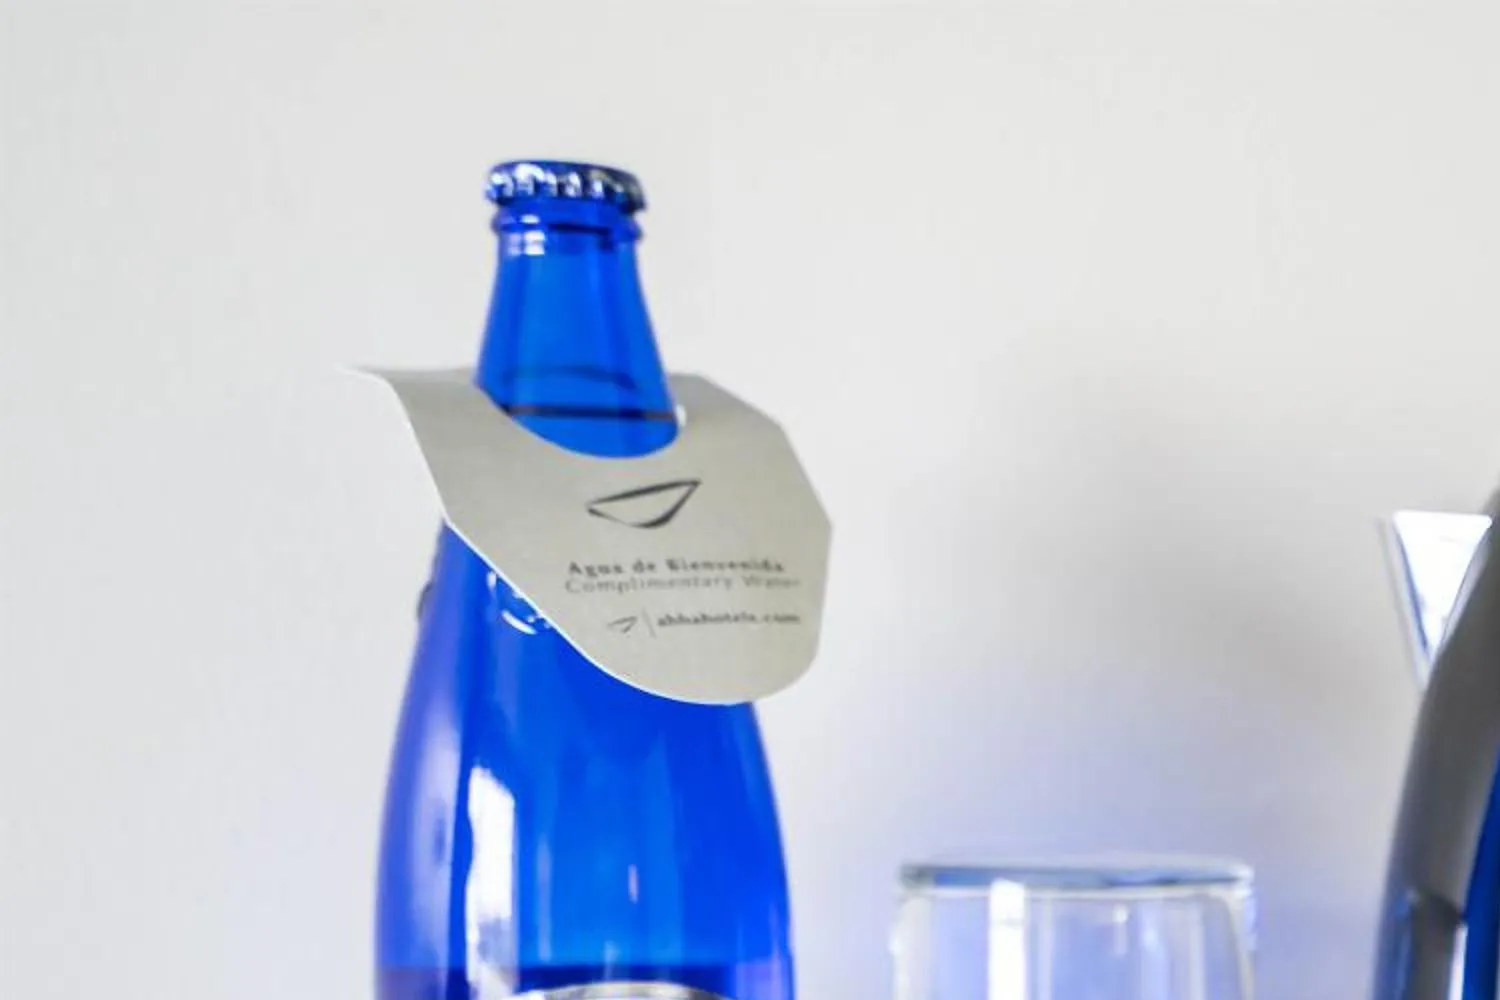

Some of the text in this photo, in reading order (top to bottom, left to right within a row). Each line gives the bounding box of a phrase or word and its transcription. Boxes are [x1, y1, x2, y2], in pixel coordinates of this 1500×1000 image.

[568, 556, 785, 577] Agua de Bienvenida
[564, 575, 802, 594] Complimentary Water
